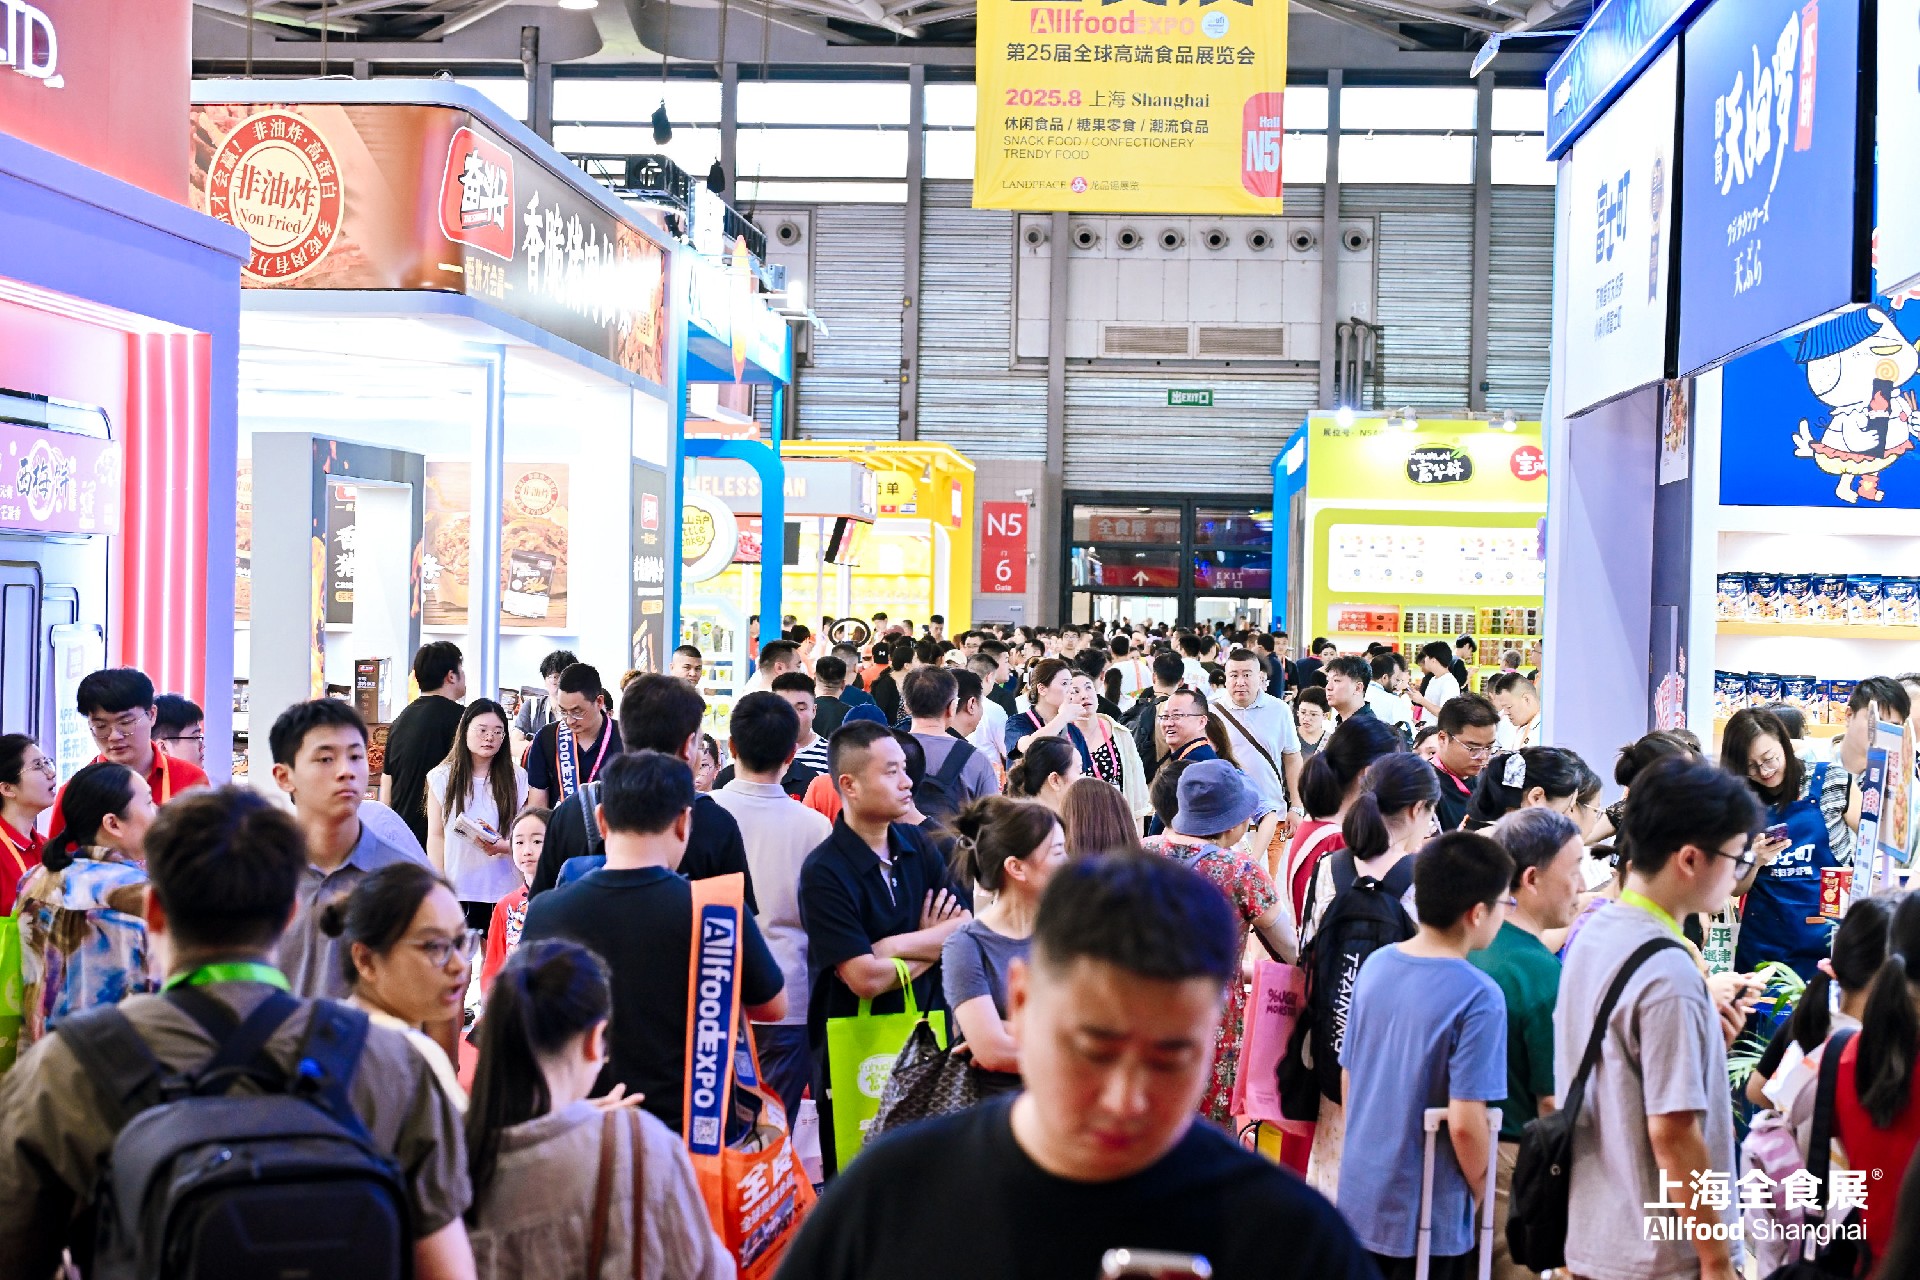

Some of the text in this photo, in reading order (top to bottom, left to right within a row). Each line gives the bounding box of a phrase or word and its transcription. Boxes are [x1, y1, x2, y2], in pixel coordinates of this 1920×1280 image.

[1006, 43, 1255, 66] 第25届全球高端食品展览会
[1005, 88, 1210, 110] 2025.8 上海 Shanghai
[1004, 116, 1064, 133] 休闲食品
[1076, 117, 1136, 133] 糖果零食
[1149, 118, 1209, 134] 潮流食品
[1259, 116, 1280, 128] Hall
[1003, 136, 1044, 147] SNACK
[1046, 136, 1081, 147] FOOD
[1091, 137, 1194, 148] CONFECTIONERY
[1246, 131, 1280, 173] N5
[1003, 149, 1090, 160] TRENDY FOOD
[236, 163, 318, 216] 非油炸
[239, 208, 302, 235] Non Fried
[988, 513, 1023, 537] N5
[1097, 518, 1147, 536] 全食展
[996, 560, 1011, 582] 6
[1216, 572, 1243, 580] EXIT
